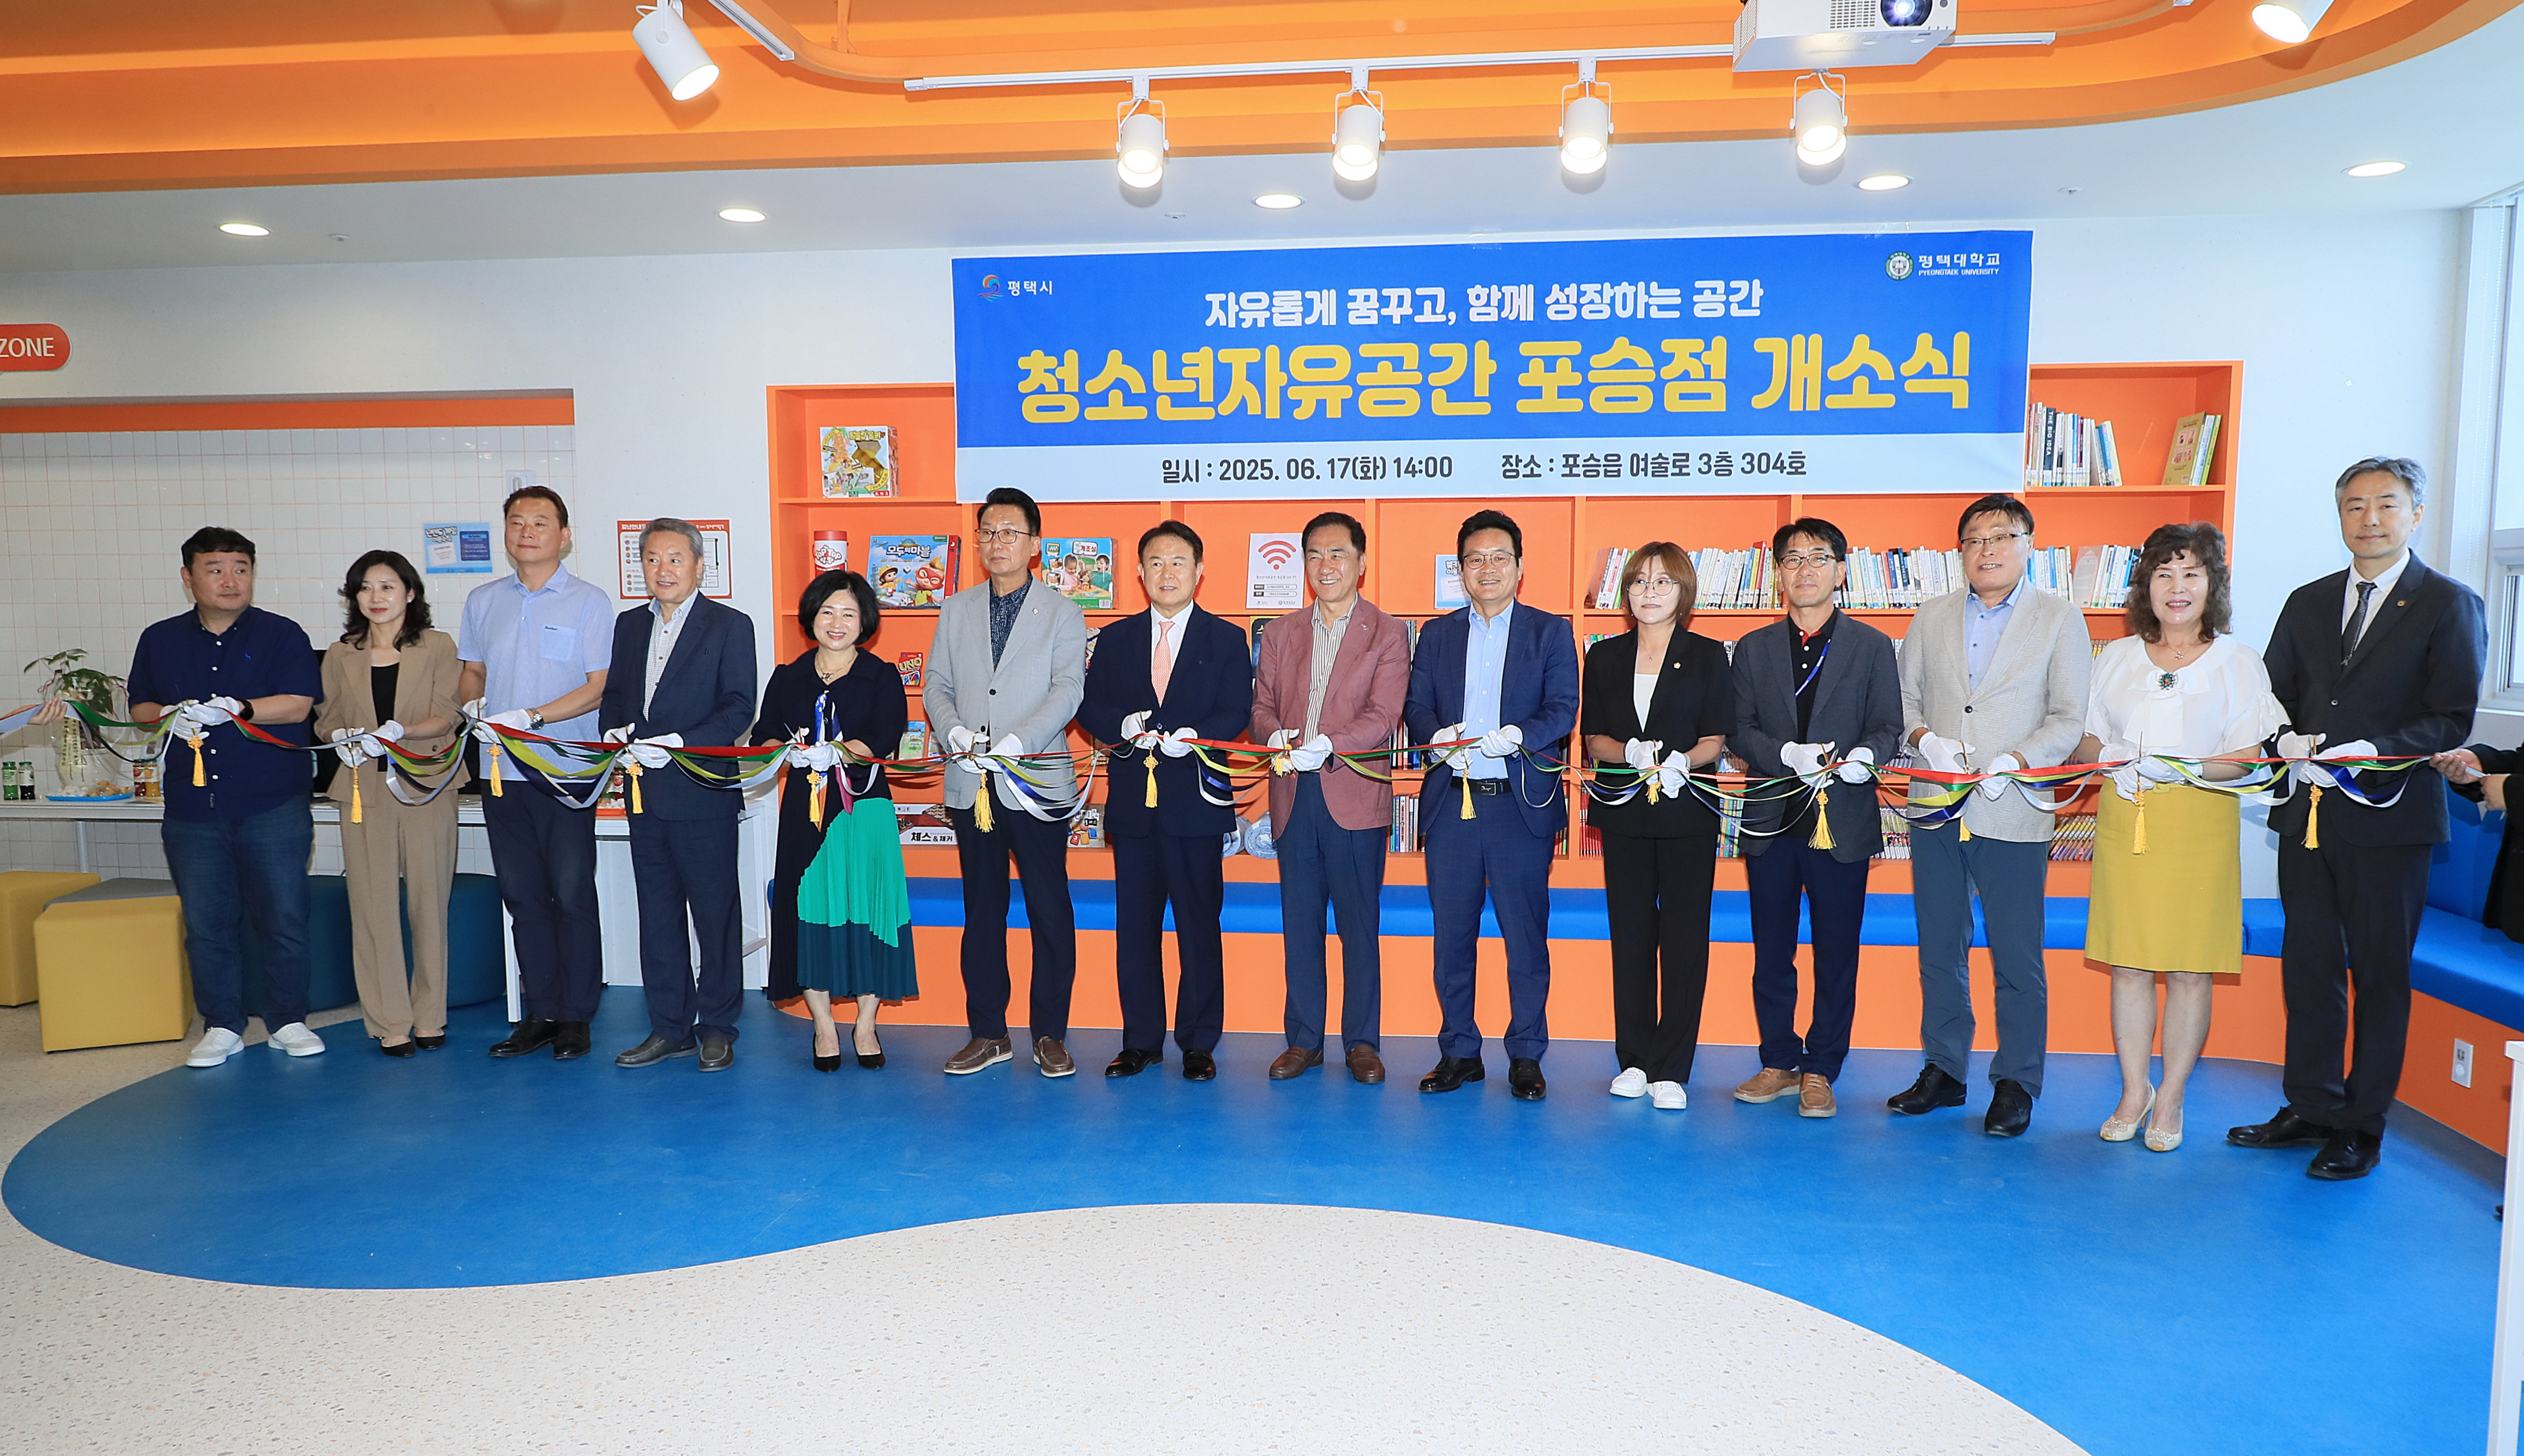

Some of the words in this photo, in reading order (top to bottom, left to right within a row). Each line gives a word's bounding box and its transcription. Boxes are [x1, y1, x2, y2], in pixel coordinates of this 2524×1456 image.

[1919, 253, 1999, 268] 평택대학교
[1008, 281, 1052, 296] 평택시
[1205, 289, 1336, 328] 자유롭게
[1347, 287, 1456, 325] 꿈꾸고,
[1467, 284, 1534, 322] 함께
[1545, 281, 1681, 320] 성장하는
[1693, 279, 1764, 318] 공간
[0, 337, 55, 357] ZONE
[1019, 341, 1497, 423] 청소년자유공간
[1517, 337, 1727, 413] 포승점
[1753, 332, 1970, 410] 개소식
[1163, 459, 1199, 483] 일시
[1220, 459, 1279, 480] 2025.
[1287, 458, 1320, 479] 06.
[1328, 457, 1386, 480] 17(화)
[1393, 457, 1452, 478] 14:00
[1502, 455, 1541, 478] 장소
[1561, 453, 1622, 477] 포승읍
[1630, 453, 1690, 477] 여술로
[1698, 451, 1733, 476] 3층
[1741, 451, 1806, 475] 304호
[815, 548, 827, 560] TOP
[827, 549, 842, 560] TOP
[886, 546, 931, 558] 모두의마블
[899, 657, 922, 672] UNO
[911, 832, 931, 842] 체스
